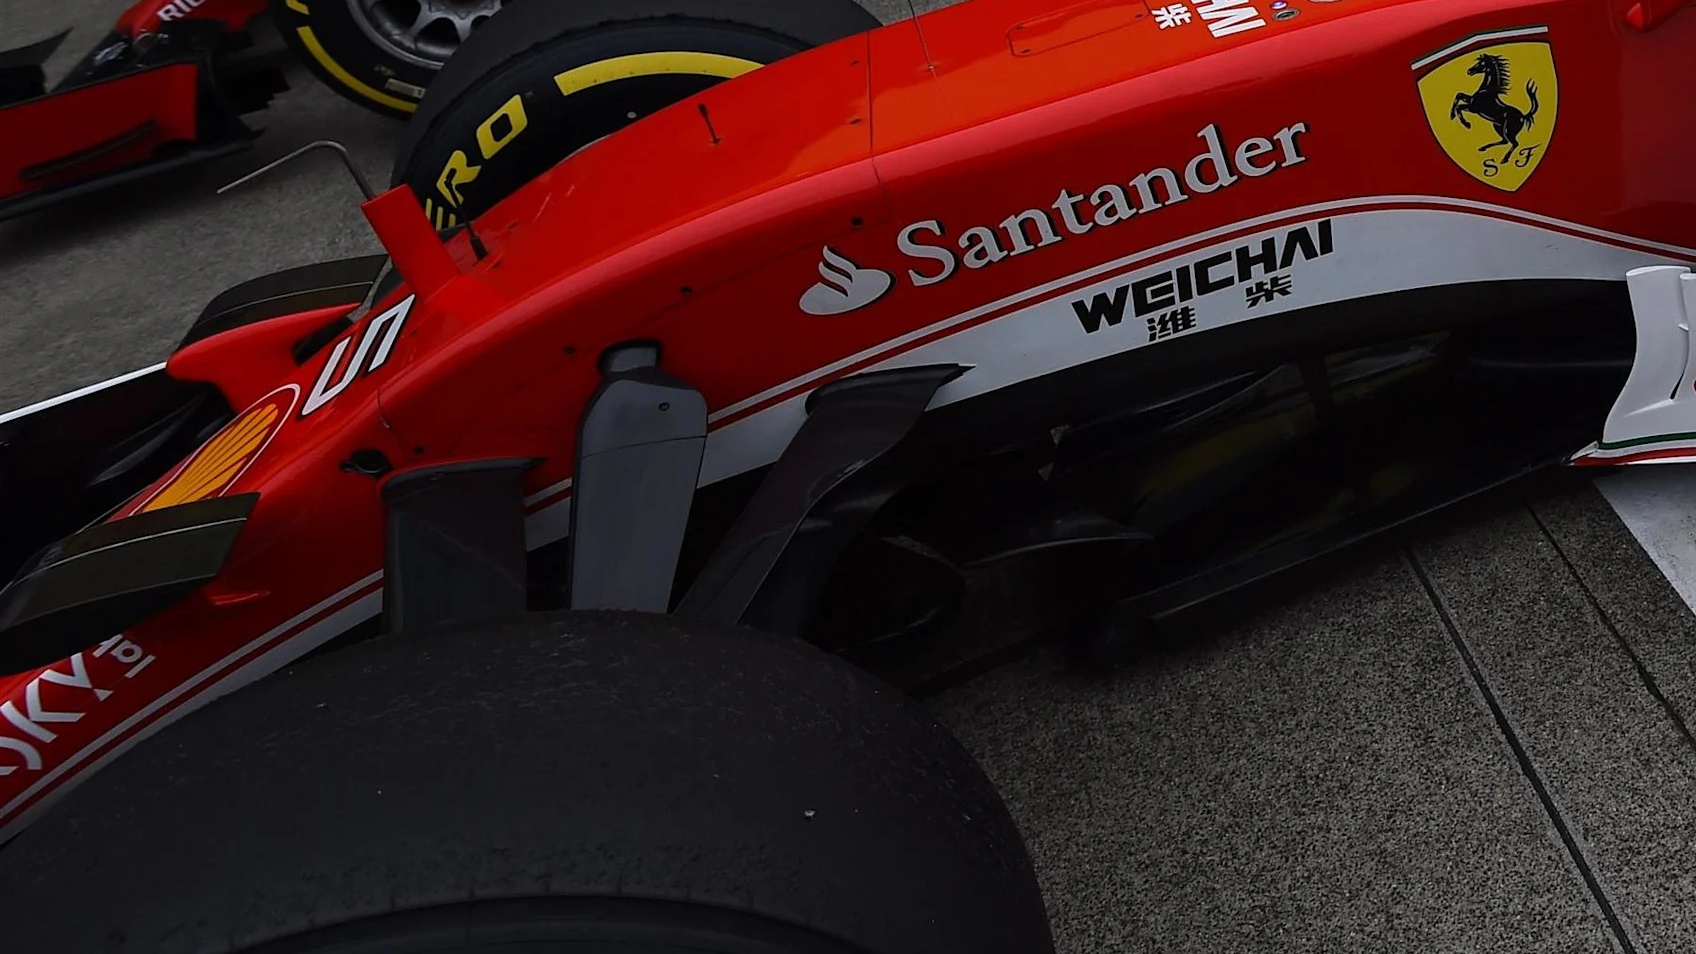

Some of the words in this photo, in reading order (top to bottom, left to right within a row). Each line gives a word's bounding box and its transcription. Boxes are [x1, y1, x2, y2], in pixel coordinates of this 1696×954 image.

[426, 93, 528, 233] ERO
[896, 122, 1309, 287] Santander
[1071, 219, 1334, 335] WEICHAI
